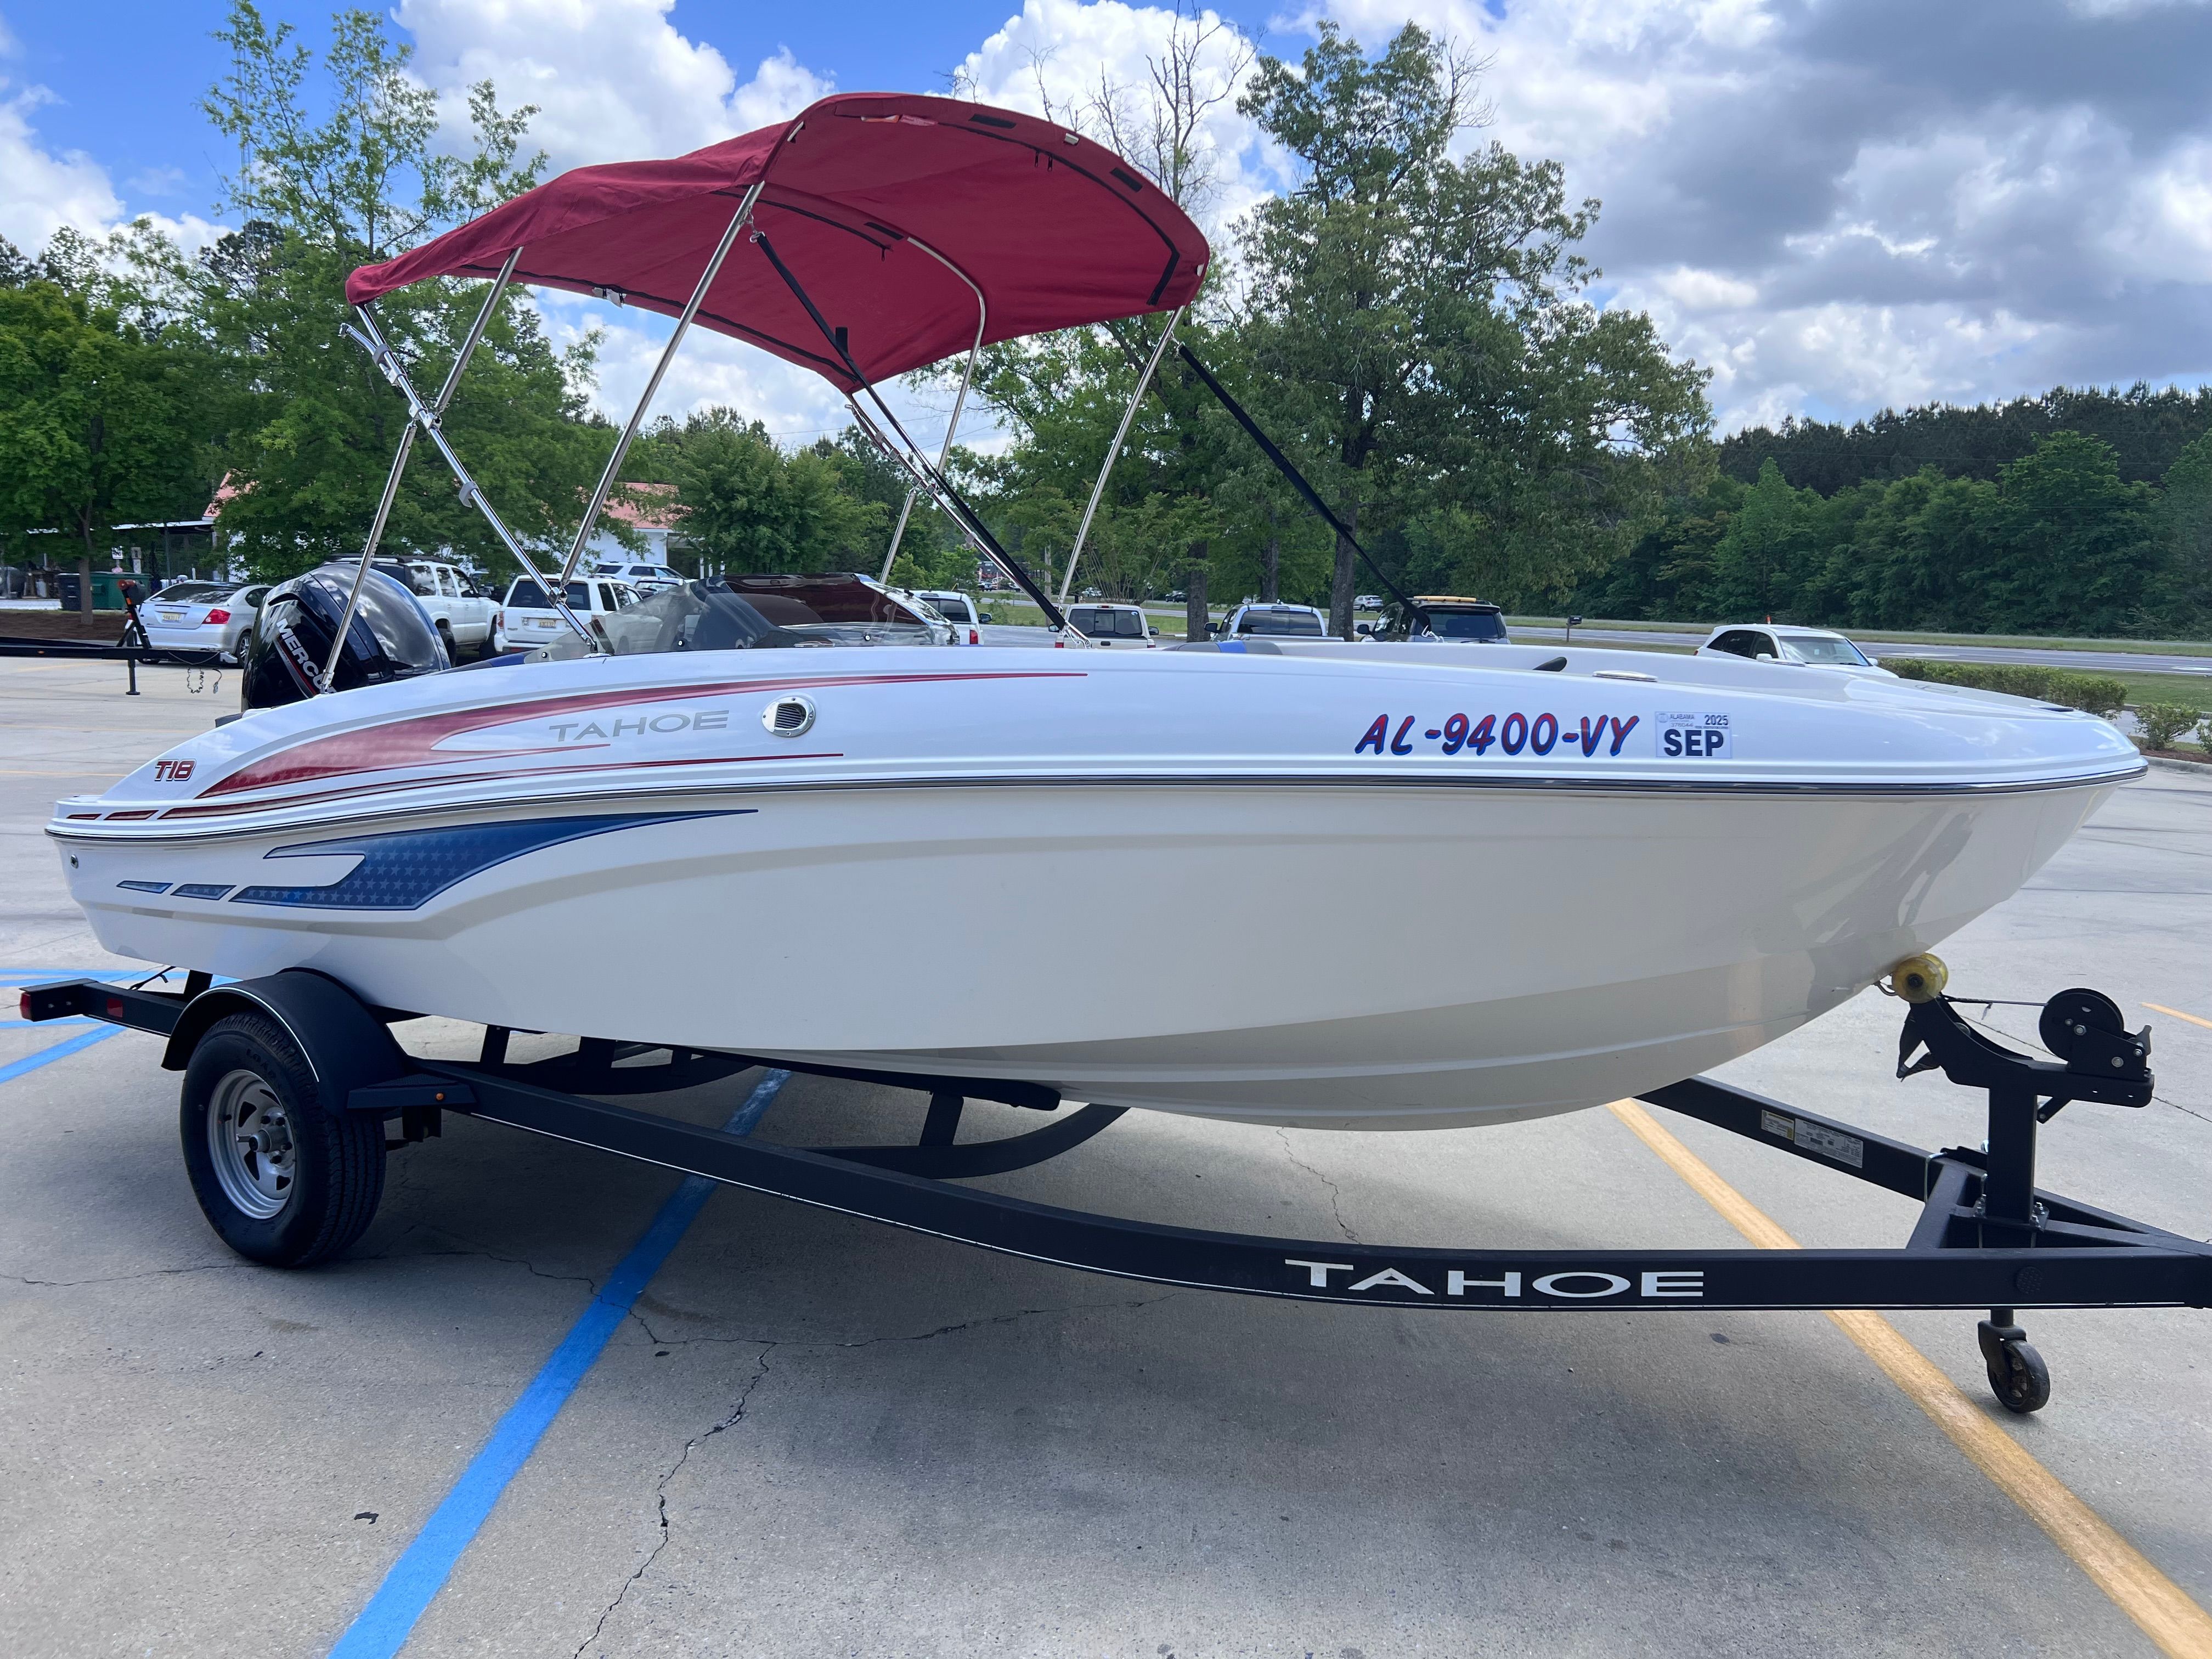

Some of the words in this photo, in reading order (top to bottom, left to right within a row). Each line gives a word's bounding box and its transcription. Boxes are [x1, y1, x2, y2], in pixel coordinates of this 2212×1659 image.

[276, 618, 337, 693] MERCU
[549, 710, 730, 742] TAHOE
[1355, 712, 1640, 758] AL-9400-VY
[1705, 715, 1729, 726] 2025
[1663, 729, 1724, 757] SEP
[154, 759, 196, 782] T18
[1284, 1259, 1704, 1297] TAHOE
